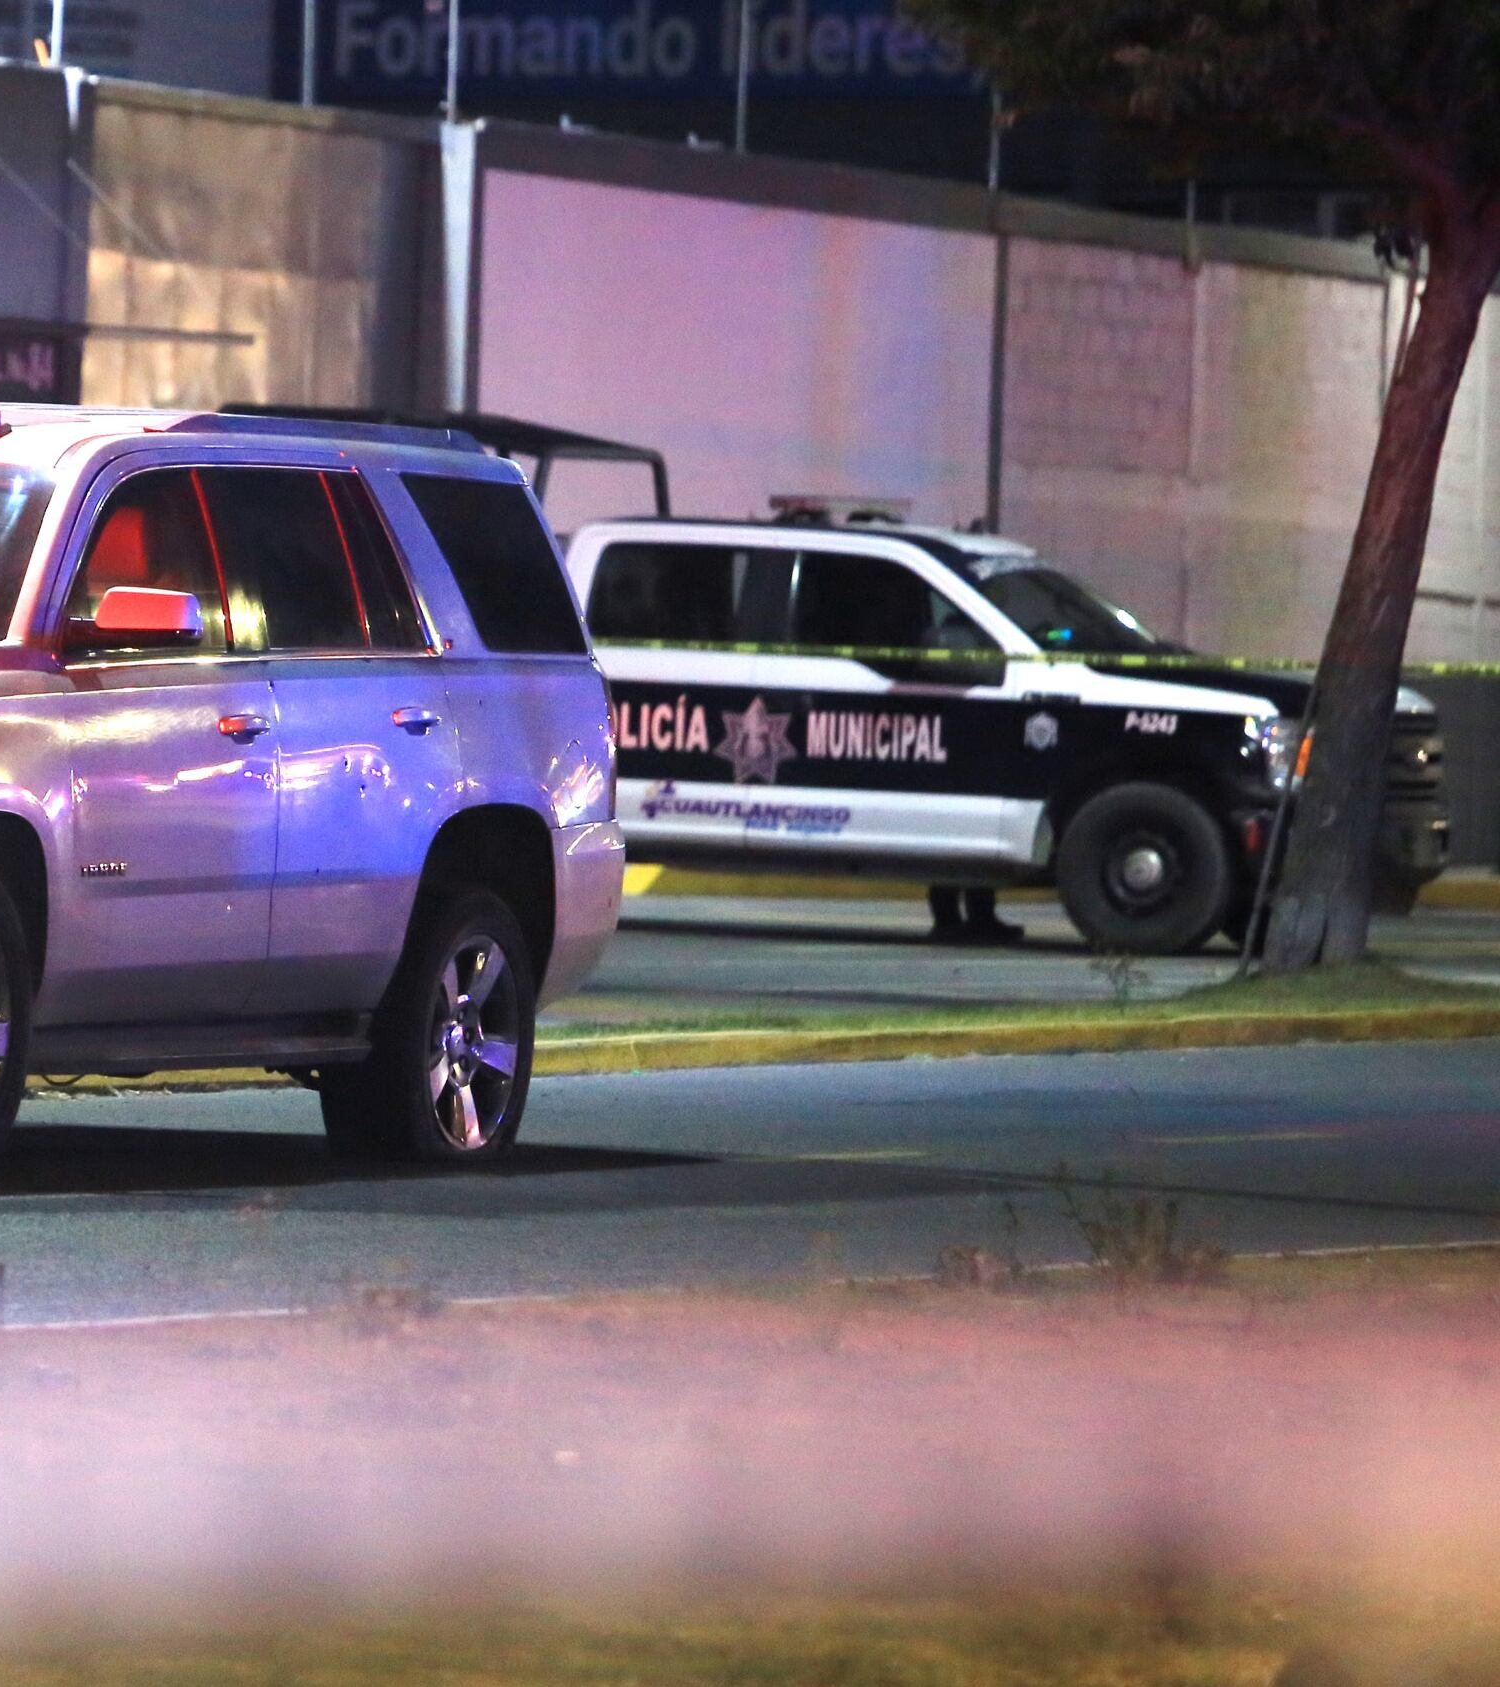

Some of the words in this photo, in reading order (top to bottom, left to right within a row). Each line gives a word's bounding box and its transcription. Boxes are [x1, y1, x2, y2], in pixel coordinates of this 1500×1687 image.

[334, 0, 697, 79] Formando
[806, 711, 948, 763] MUNICIPAL
[659, 798, 851, 824] CUAUTLANCINGO
